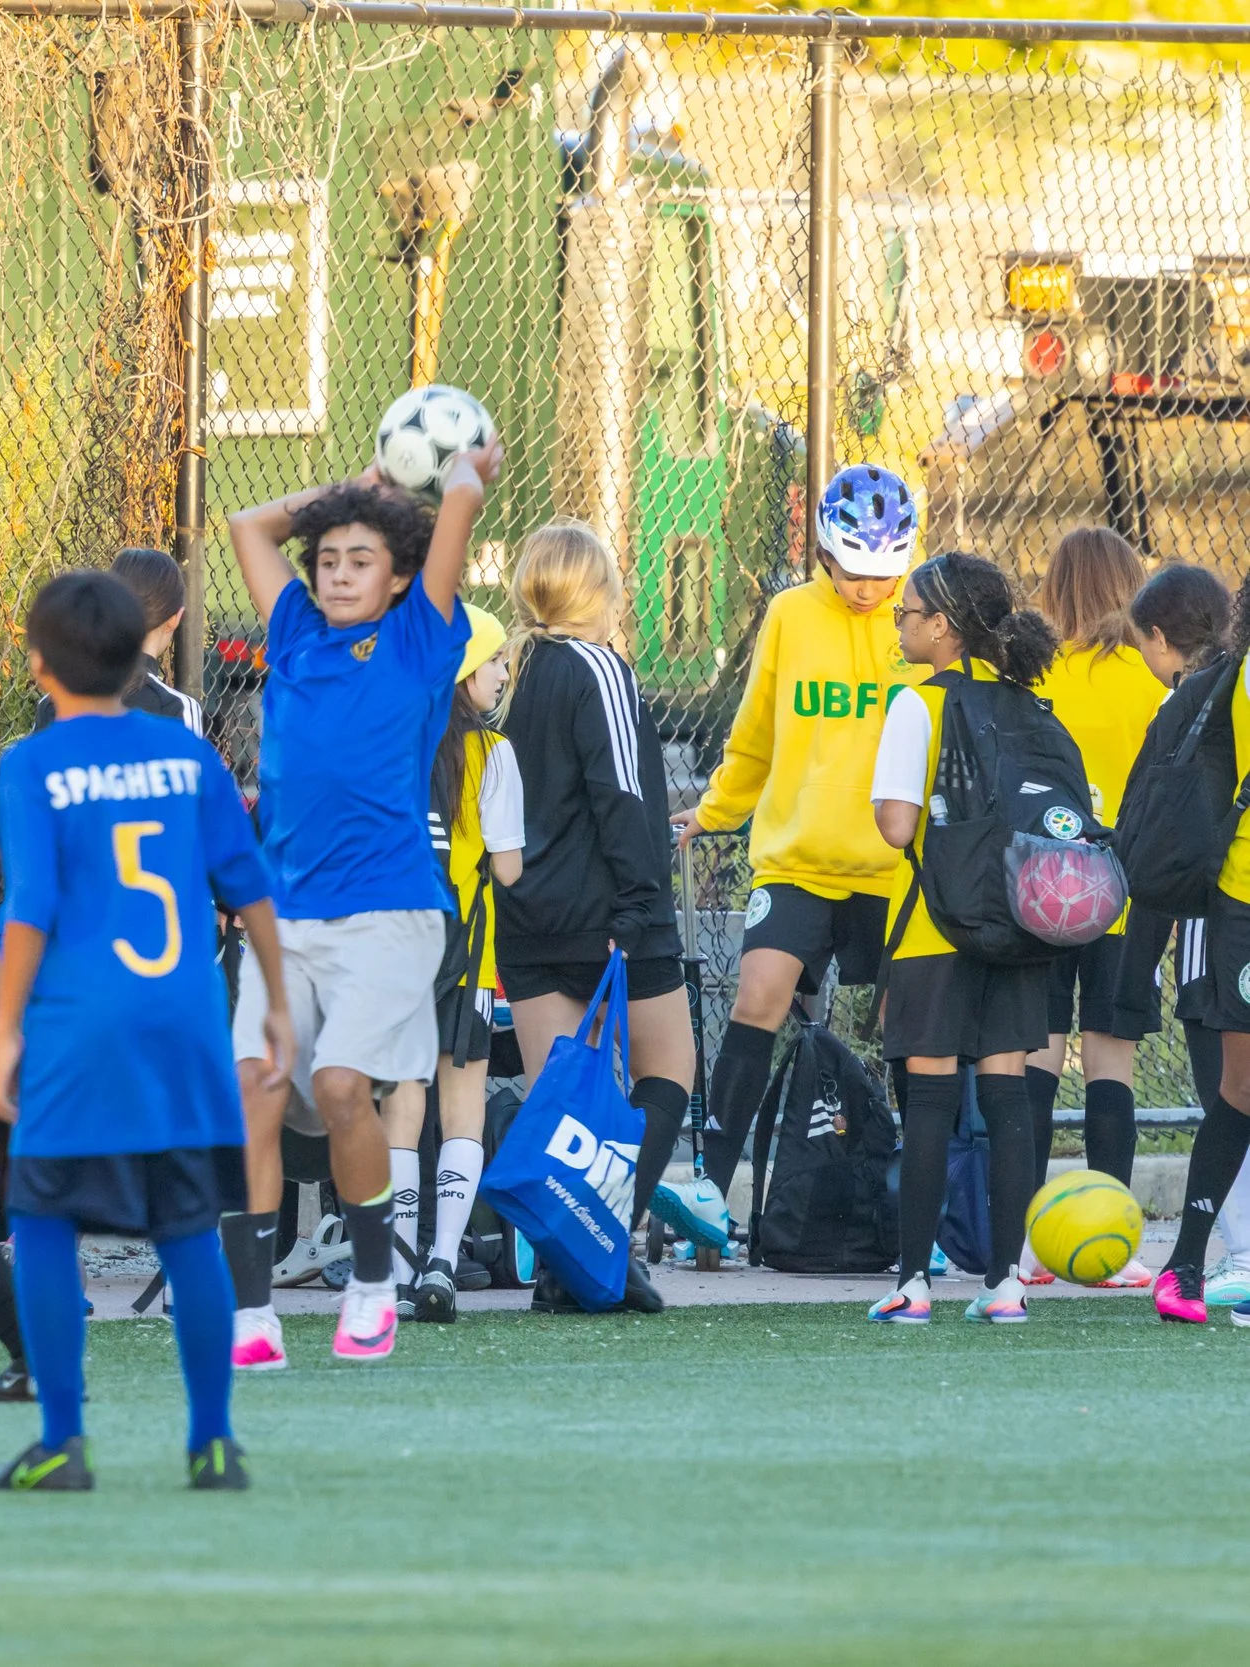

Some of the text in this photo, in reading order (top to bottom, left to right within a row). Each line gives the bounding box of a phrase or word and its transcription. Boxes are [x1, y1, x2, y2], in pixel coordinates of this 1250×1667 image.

[45, 758, 202, 810] SPAGHETT
[111, 820, 183, 978] 5
[395, 1210, 418, 1219] mbr
[437, 1189, 465, 1199] mbro
[544, 1175, 616, 1254] www.dime.com
